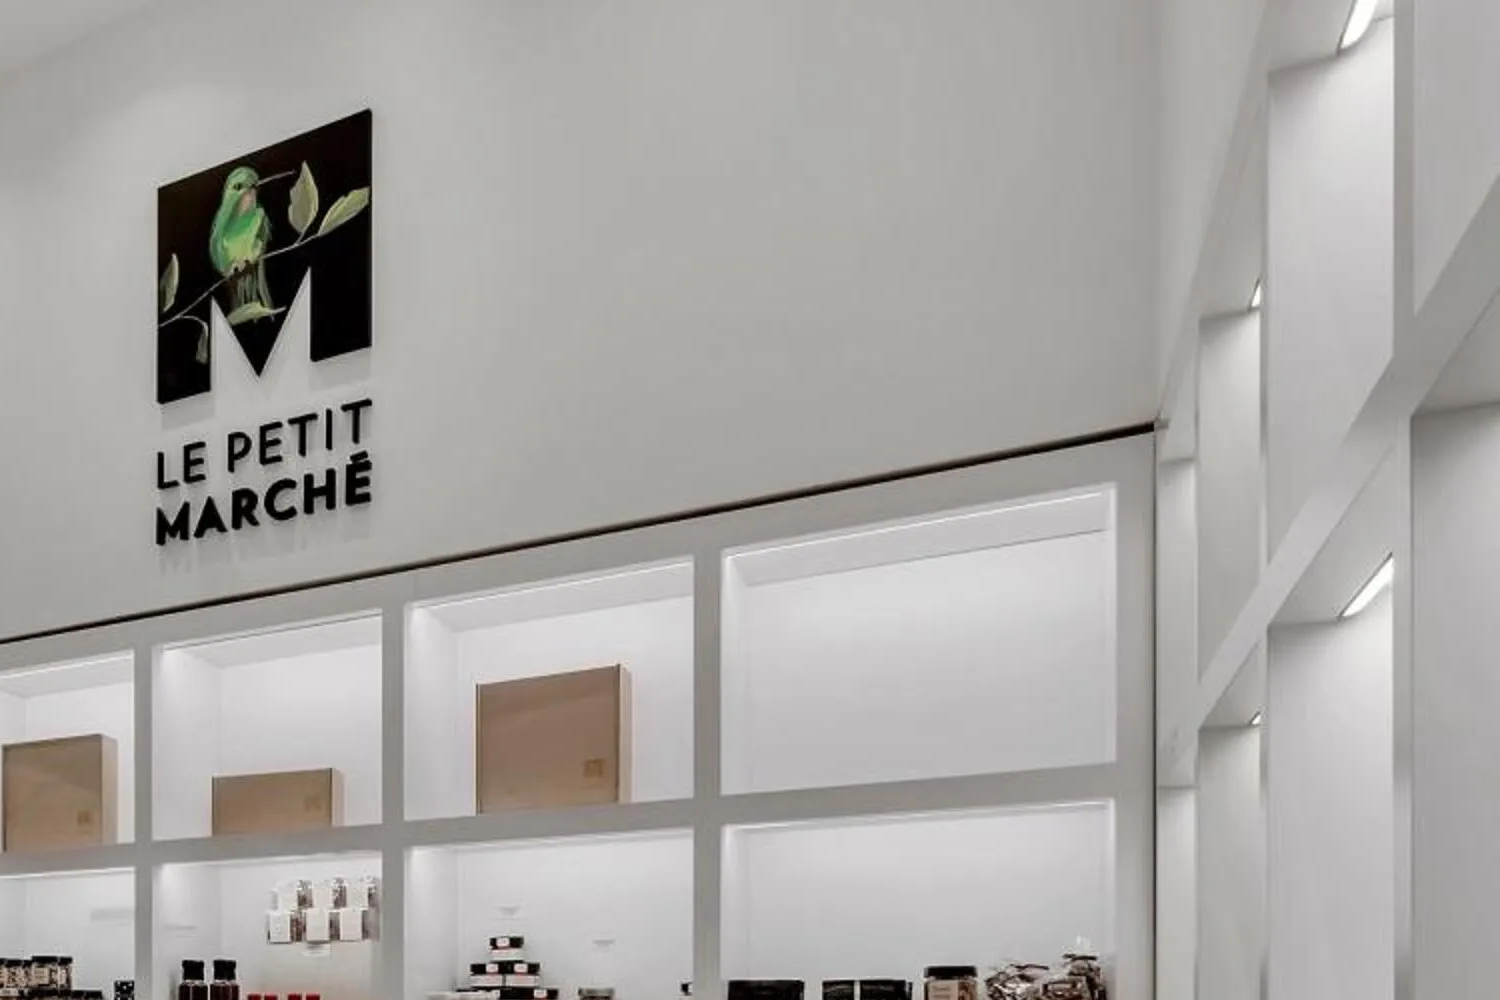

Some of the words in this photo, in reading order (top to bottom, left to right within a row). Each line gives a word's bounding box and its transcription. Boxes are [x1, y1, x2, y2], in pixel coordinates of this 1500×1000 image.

[157, 440, 206, 490] LE
[228, 398, 372, 474] PETIT
[156, 450, 372, 546] MARCHÉ
